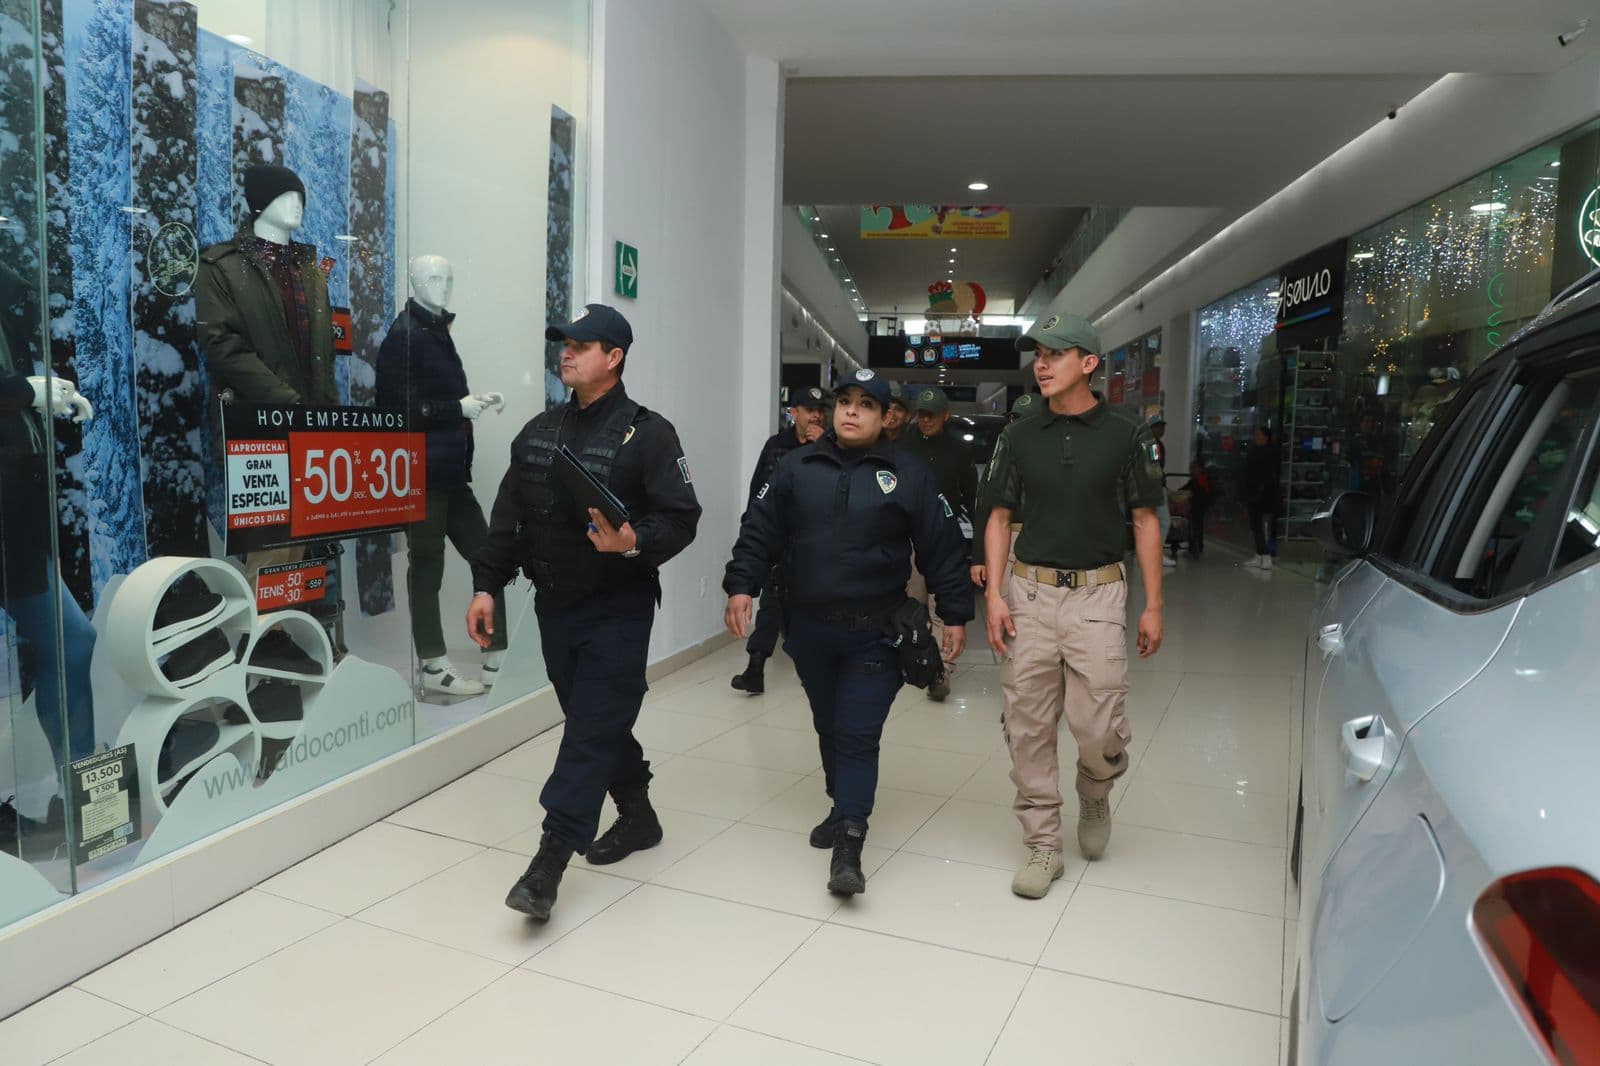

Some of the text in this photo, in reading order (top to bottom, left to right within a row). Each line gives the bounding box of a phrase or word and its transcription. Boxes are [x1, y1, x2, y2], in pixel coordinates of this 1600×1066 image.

[258, 409, 404, 427] HOY EMPEZAMOS
[230, 442, 285, 453] ¡APROVECHA!
[246, 459, 272, 470] GRAN
[243, 474, 279, 489] VENTA
[231, 490, 288, 509] ESPECIAL
[233, 512, 286, 527] ÚNICOS DÍAS
[259, 584, 285, 600] TENIS
